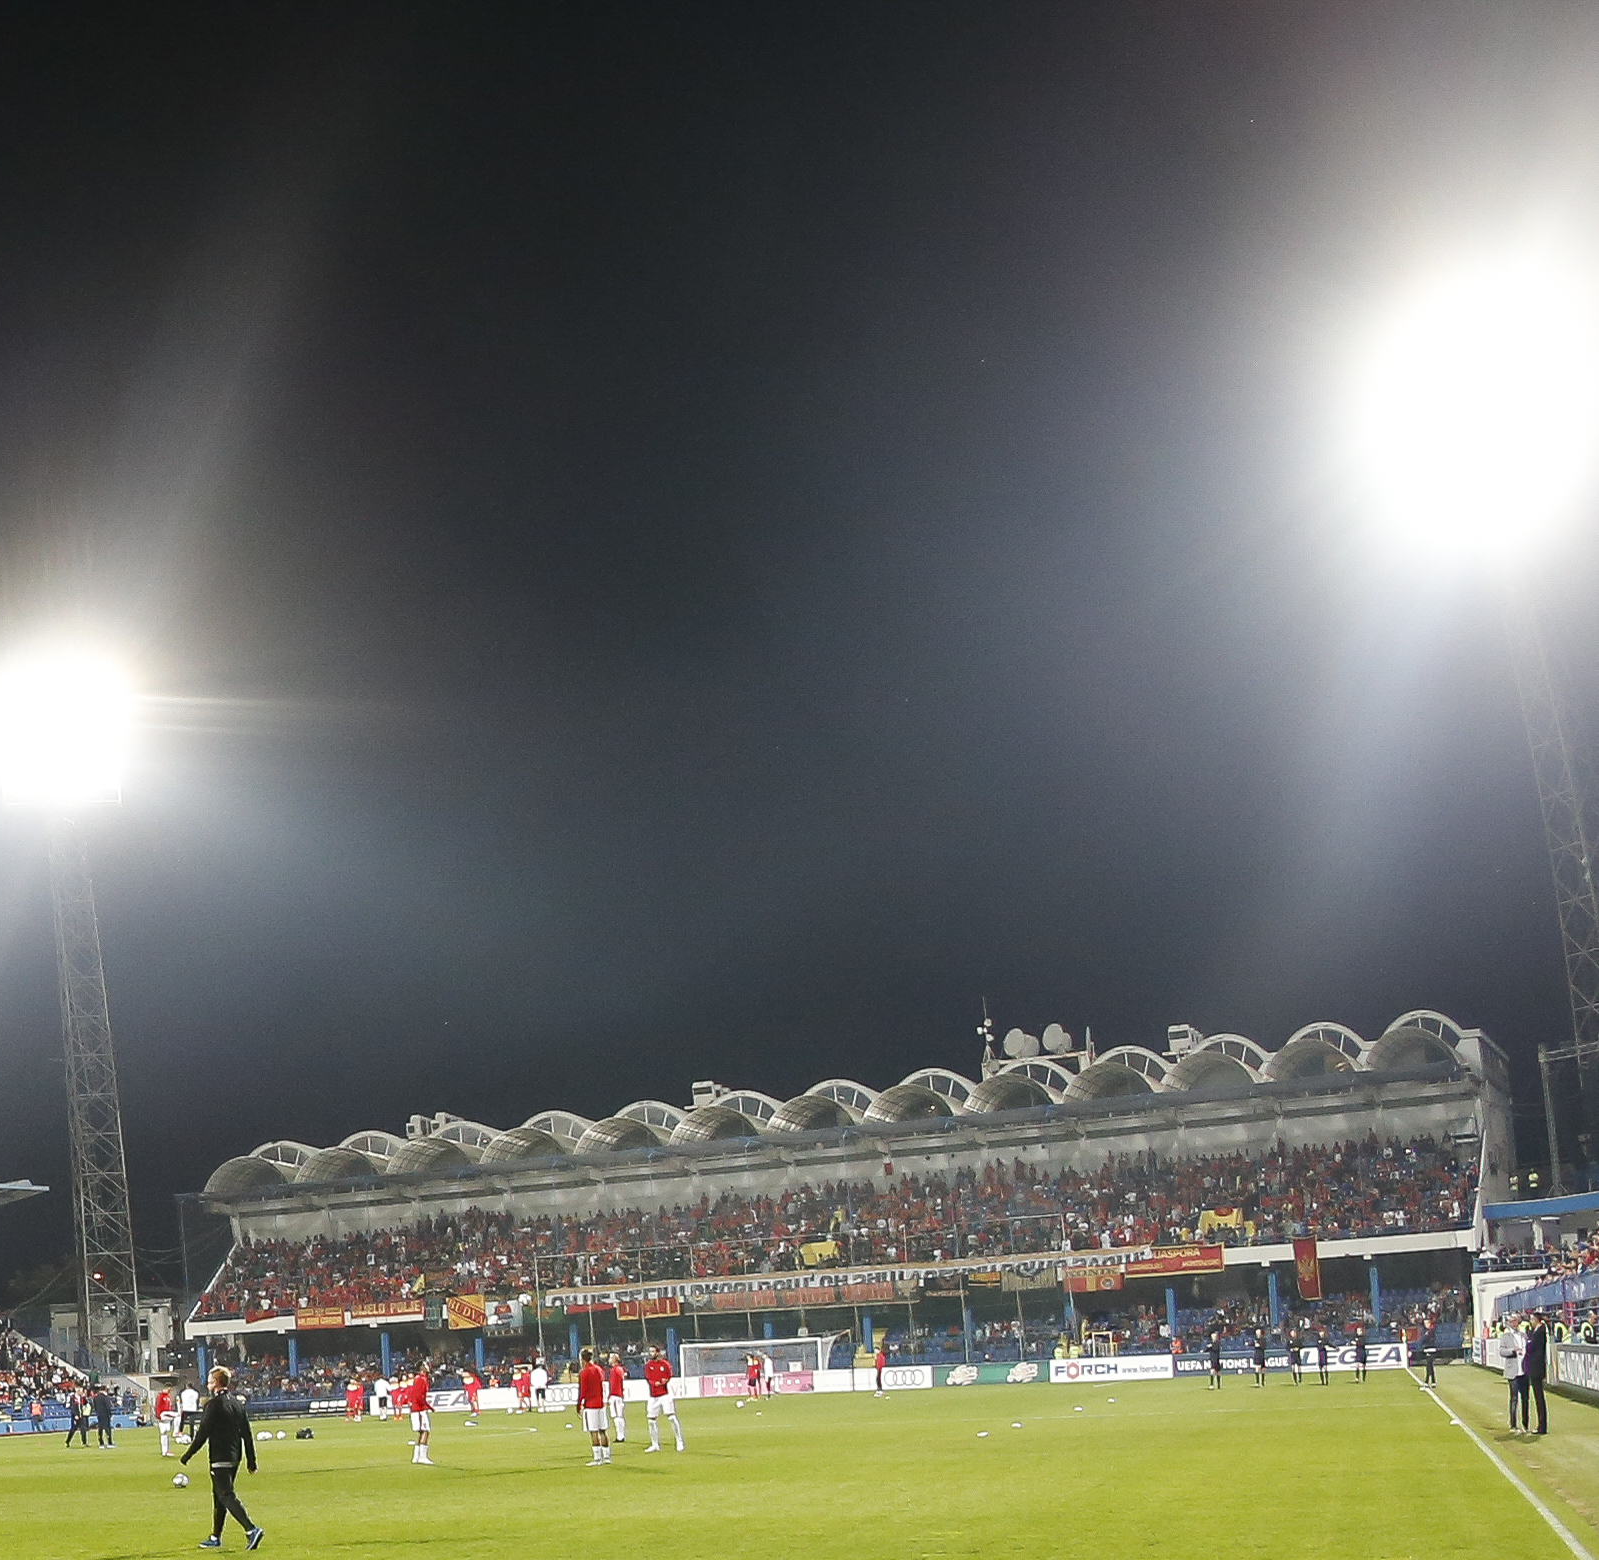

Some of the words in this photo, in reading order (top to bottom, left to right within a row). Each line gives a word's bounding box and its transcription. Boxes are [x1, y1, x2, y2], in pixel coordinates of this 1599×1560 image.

[390, 1300, 421, 1313] POLJE
[1176, 1359, 1202, 1371] UEFA
[1203, 1358, 1248, 1370] NTIONS
